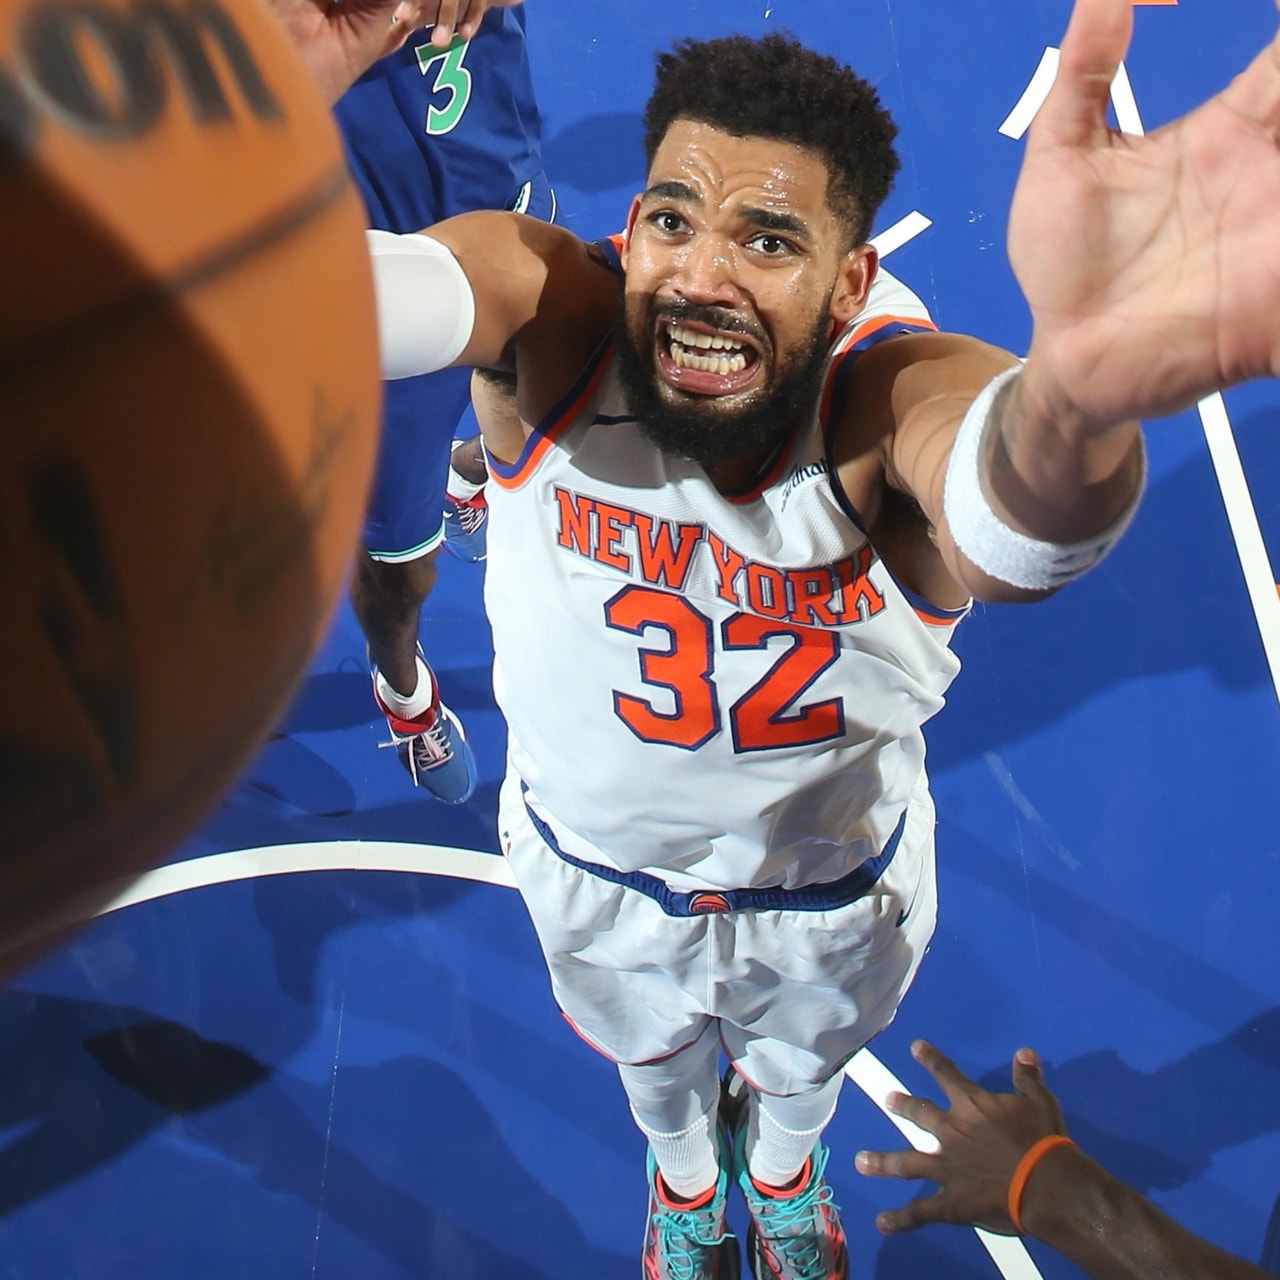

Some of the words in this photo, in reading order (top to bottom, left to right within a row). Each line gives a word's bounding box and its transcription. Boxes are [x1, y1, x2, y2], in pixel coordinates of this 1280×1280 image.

[414, 32, 472, 136] 3
[554, 487, 705, 592] NEW
[706, 525, 888, 627] YORK
[603, 583, 847, 755] 32
